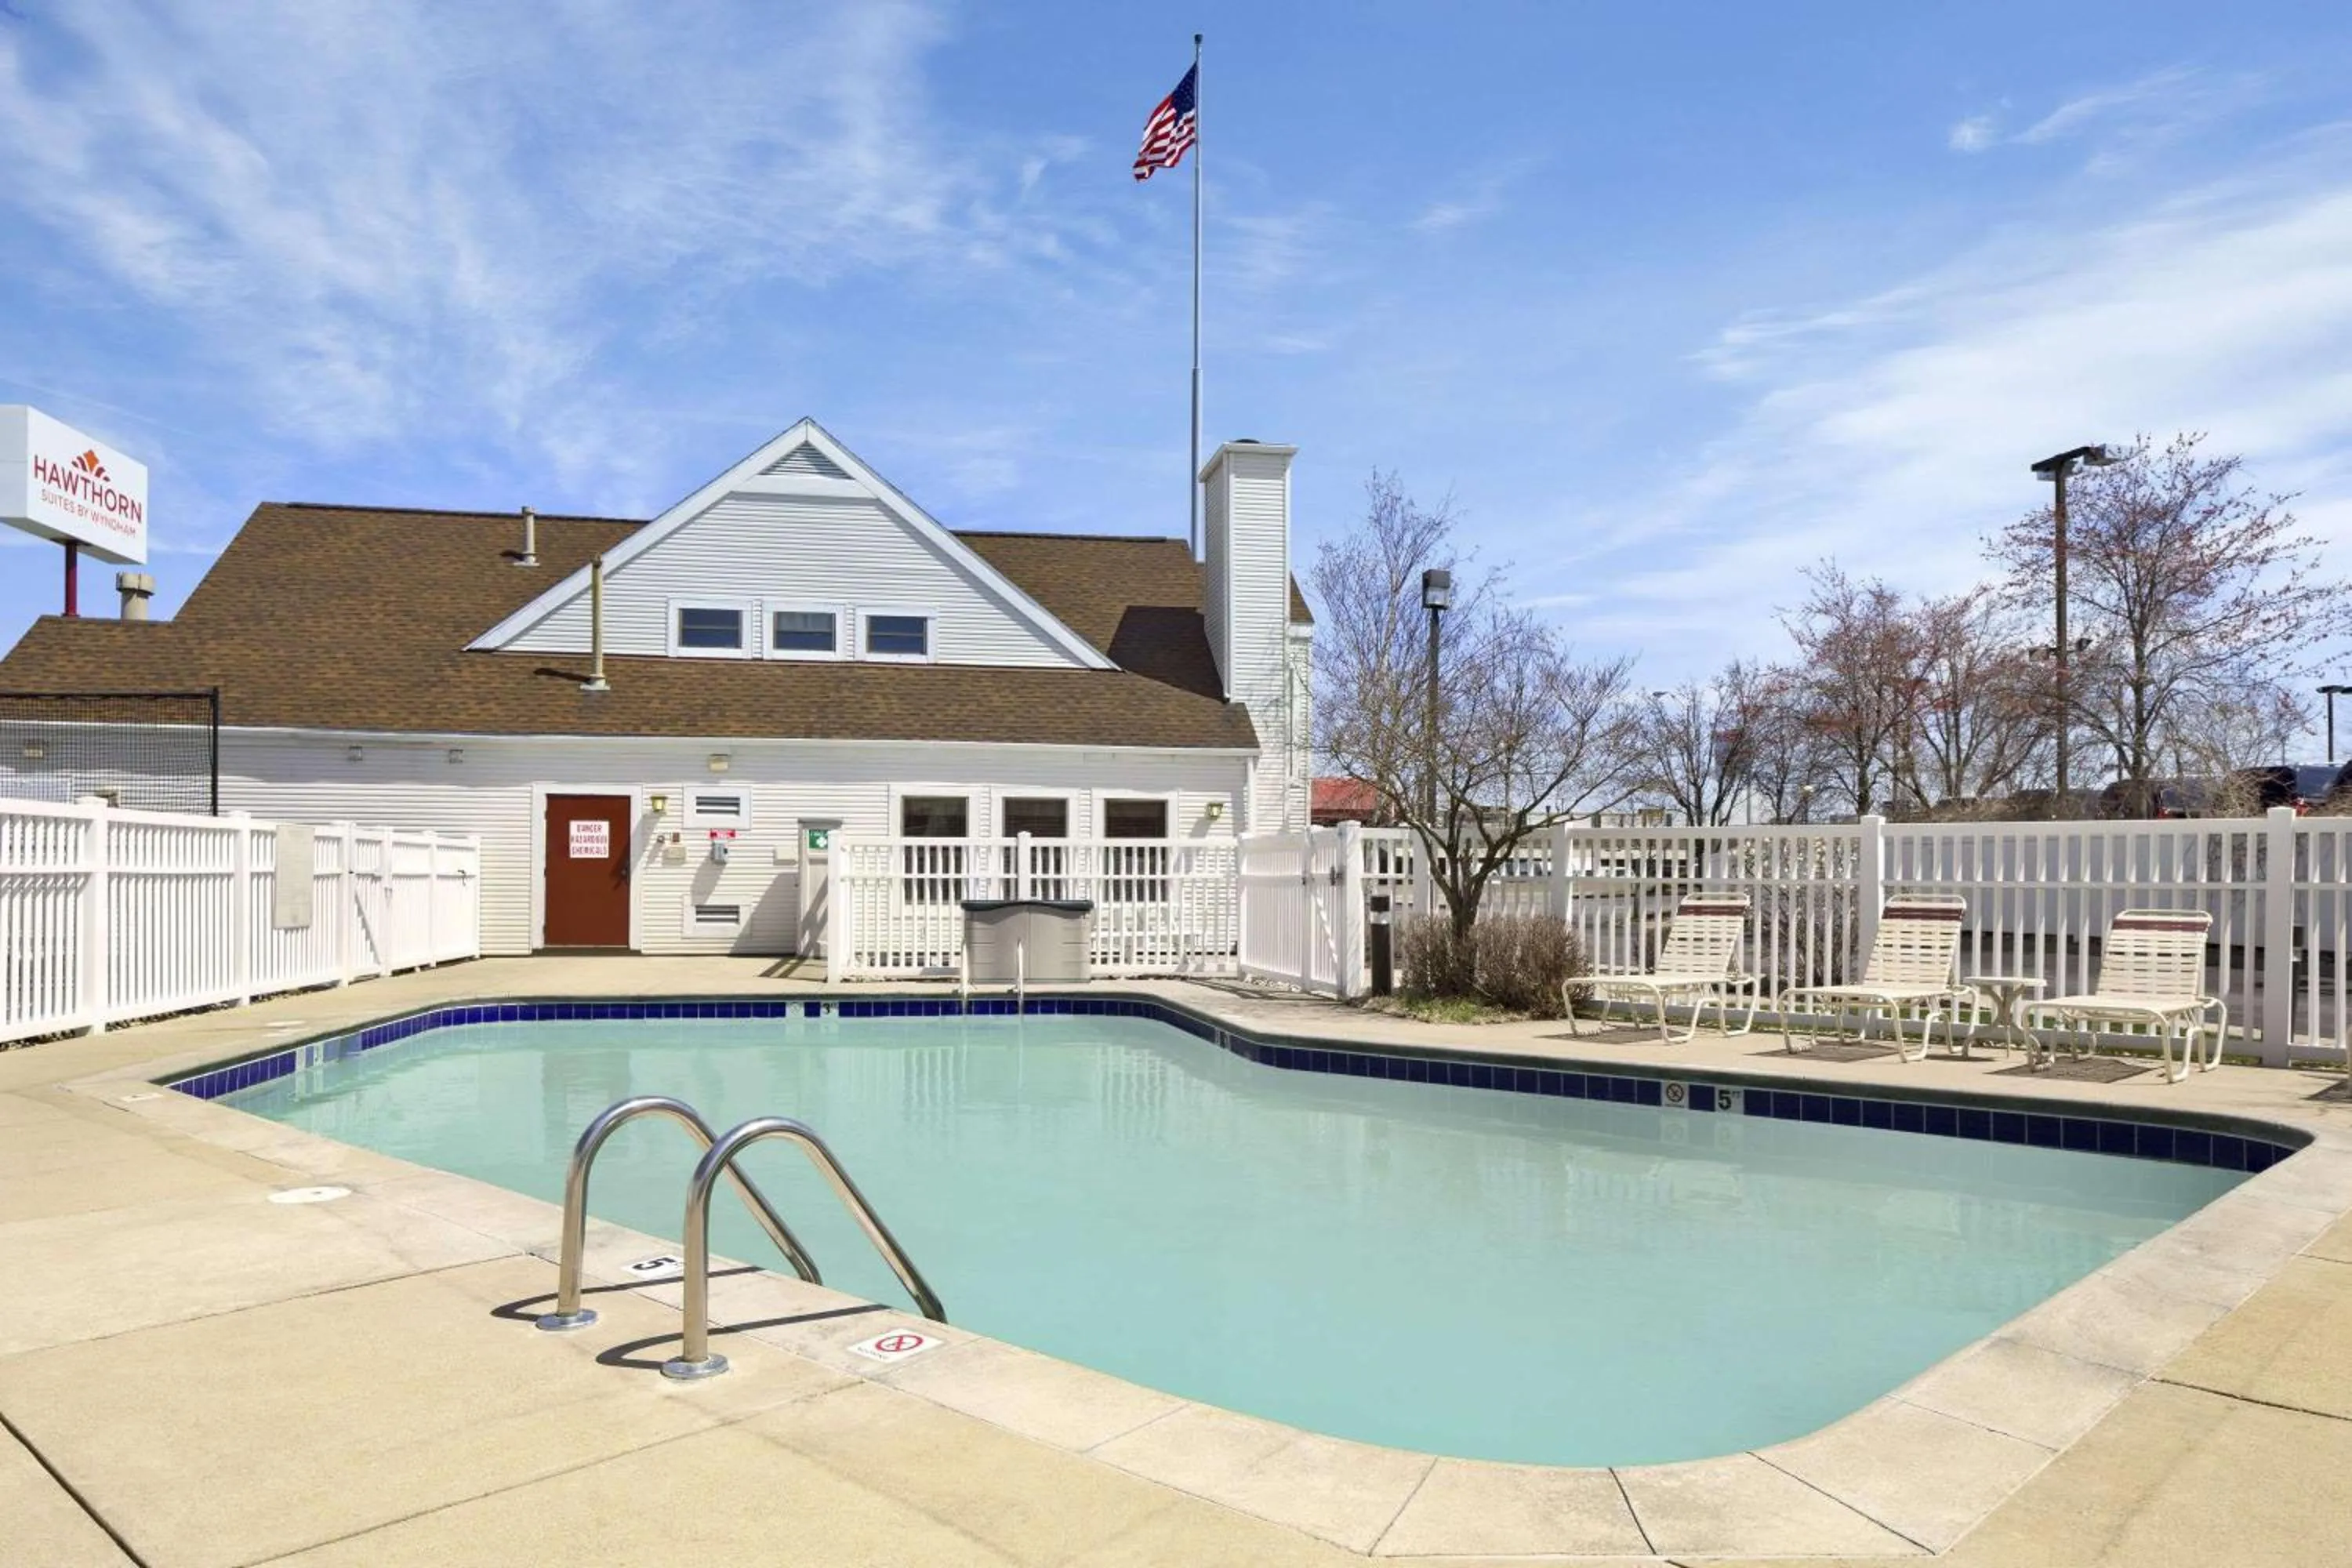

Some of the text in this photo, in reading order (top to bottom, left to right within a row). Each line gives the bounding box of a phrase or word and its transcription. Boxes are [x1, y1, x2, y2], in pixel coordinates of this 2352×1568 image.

[34, 454, 142, 524] HAWTHORN
[42, 488, 75, 514] SUITES
[77, 504, 89, 517] BY
[1718, 1089, 1731, 1110] 5
